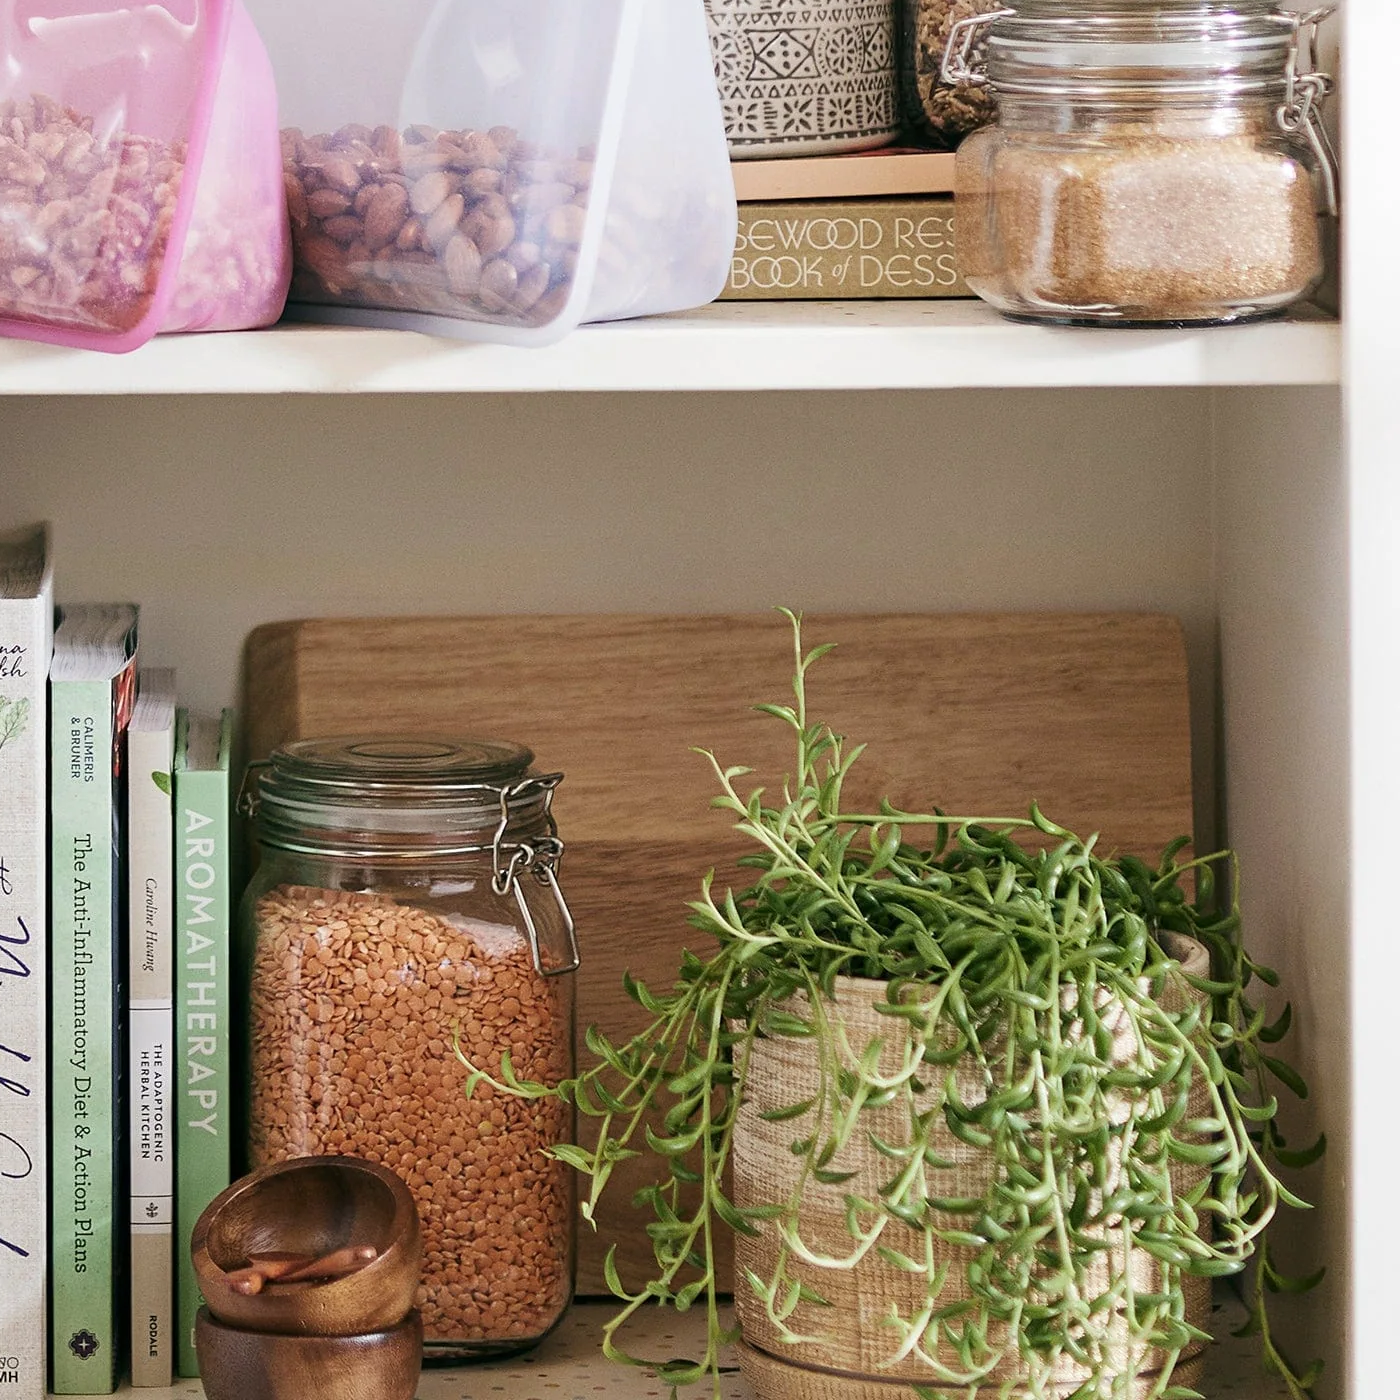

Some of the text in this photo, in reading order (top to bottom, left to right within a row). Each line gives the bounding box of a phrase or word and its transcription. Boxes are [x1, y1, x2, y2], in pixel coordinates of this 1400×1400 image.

[731, 254, 957, 289] BOOK of DESS
[70, 716, 81, 779] & BRUNER
[83, 716, 94, 782] CALIMERIS
[142, 877, 158, 972] Caroline Hwang
[184, 807, 219, 1137] AROMATHERAPY
[70, 833, 94, 1274] The Anti-Inflammatory Diet & Action Plans
[140, 1051, 150, 1159] HERBAL KITCHEN
[154, 1043, 164, 1163] THE ADAPTOGENIC
[149, 1315, 158, 1357] RODALE
